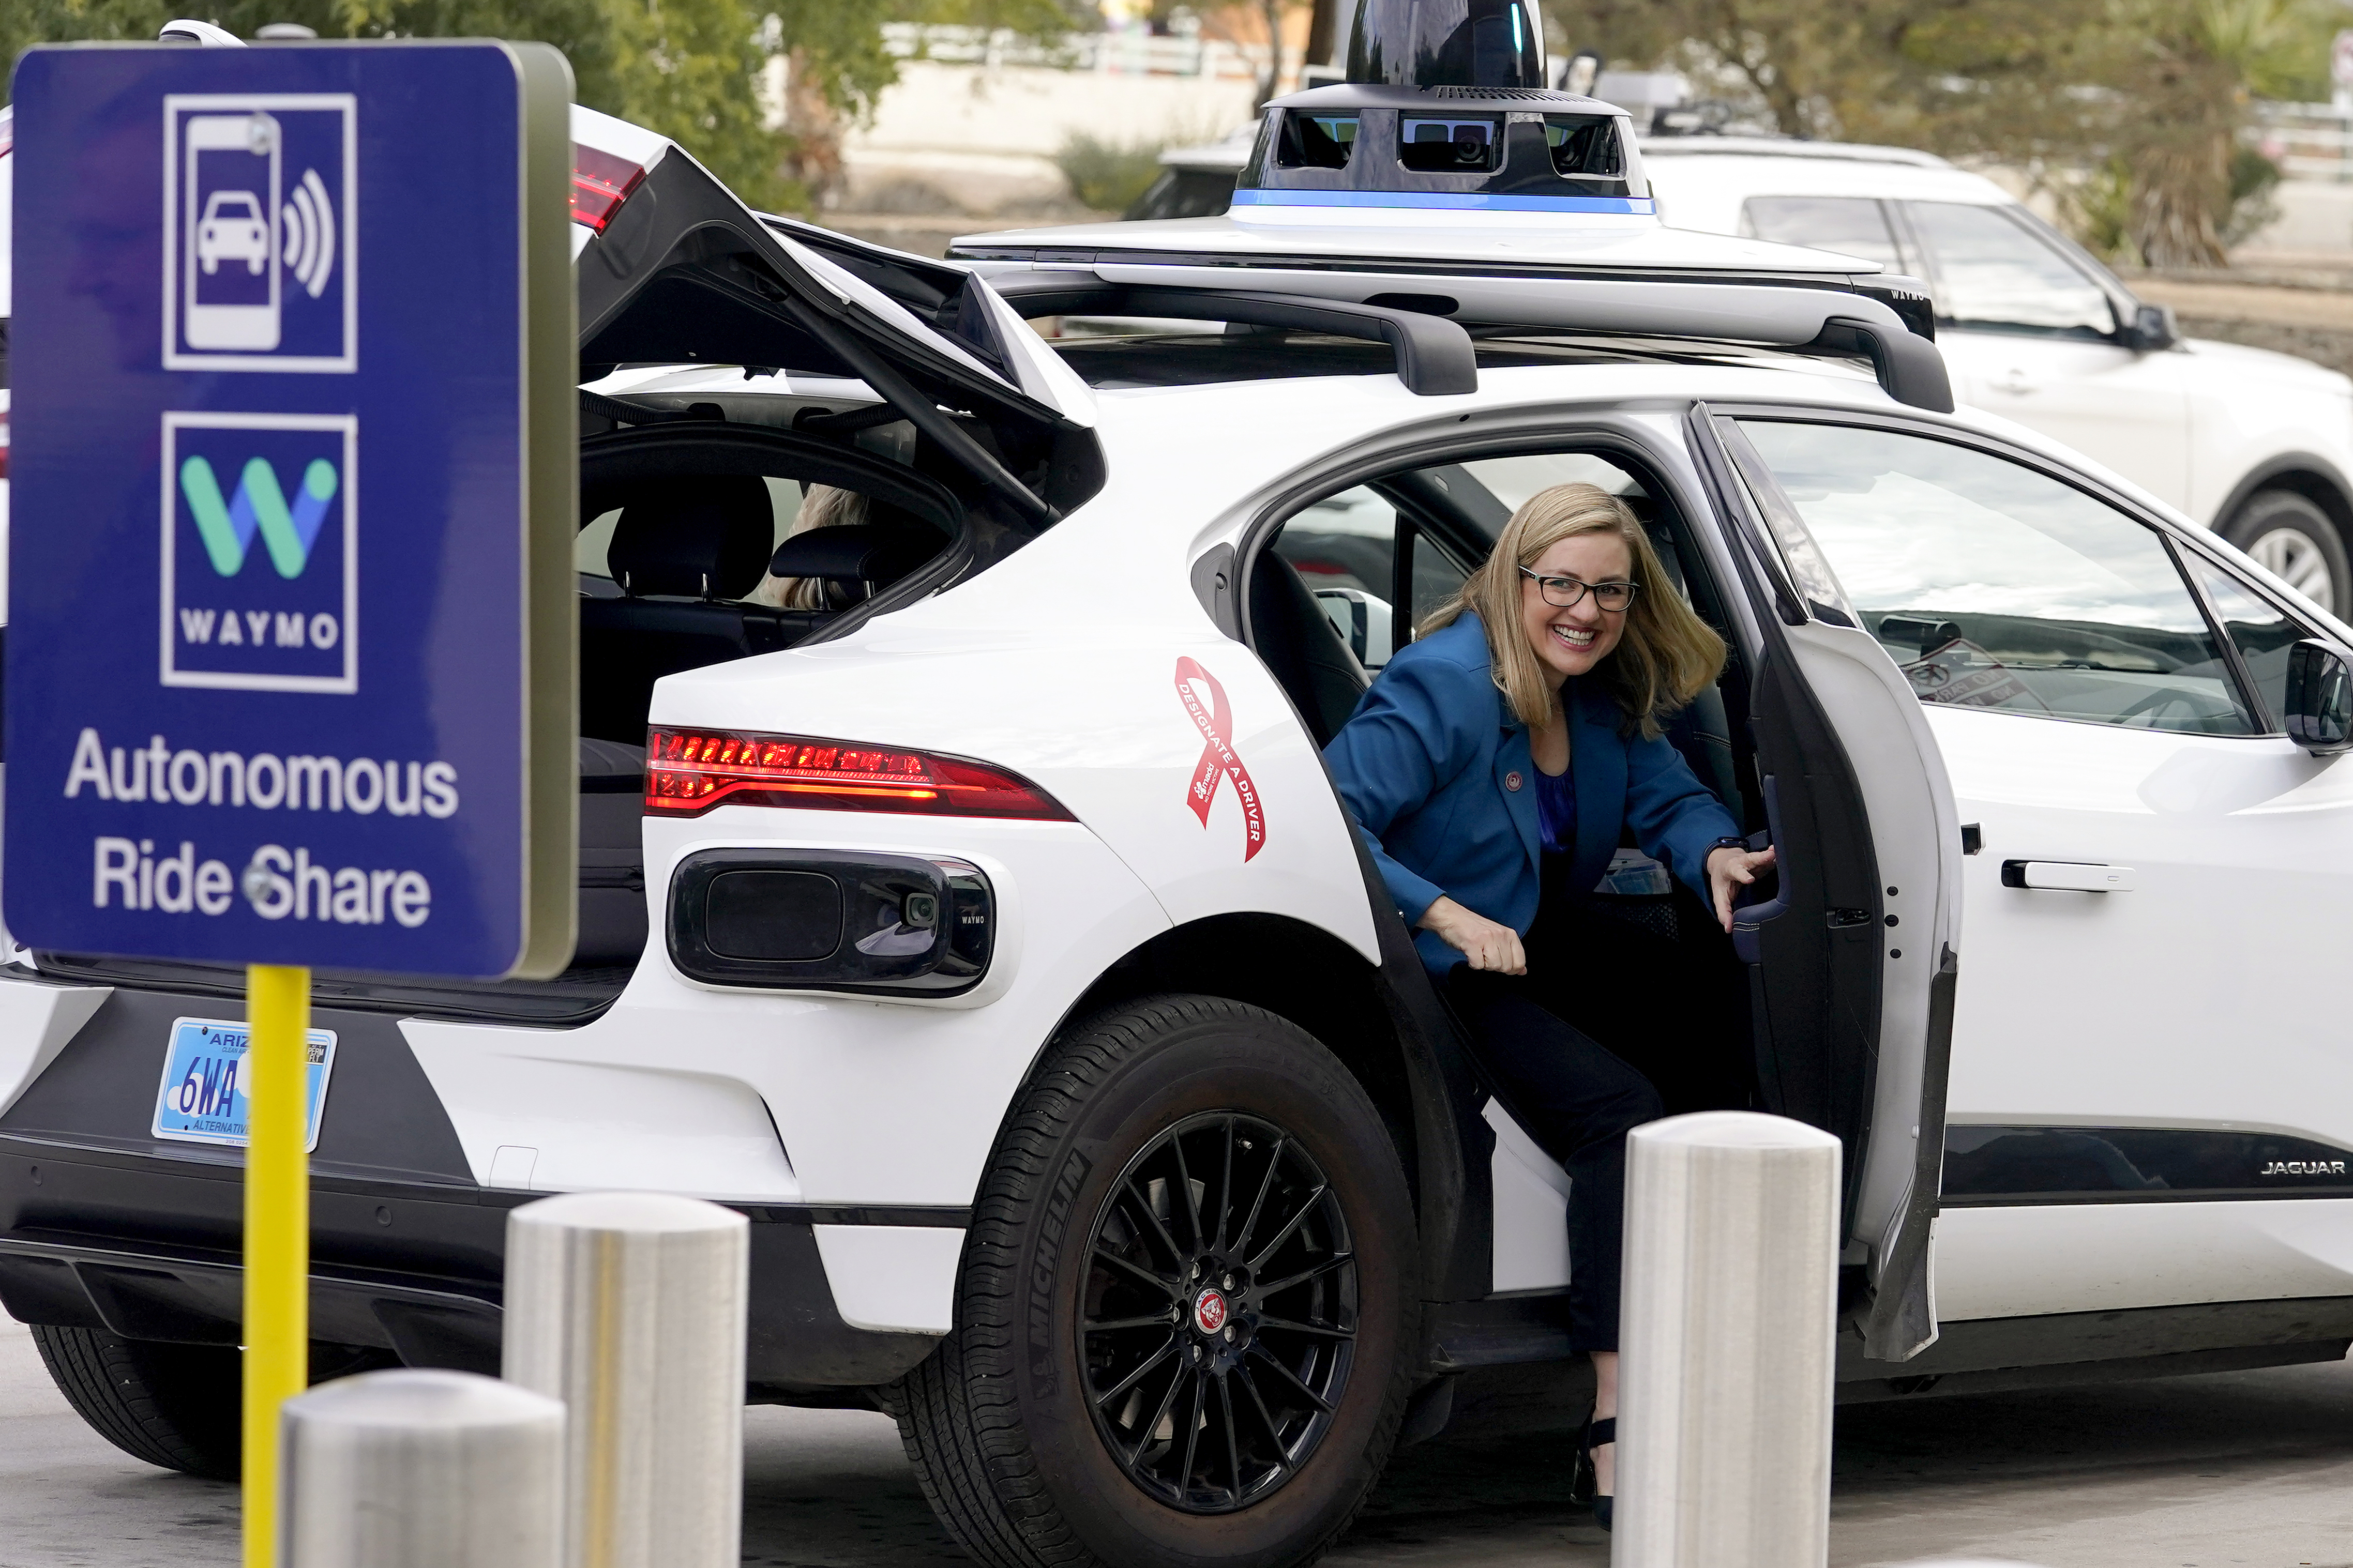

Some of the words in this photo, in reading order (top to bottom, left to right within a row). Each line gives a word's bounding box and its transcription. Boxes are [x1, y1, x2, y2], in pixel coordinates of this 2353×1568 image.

[1891, 290, 1924, 301] WAYMO
[179, 607, 339, 649] WAYMO
[64, 726, 459, 819] Autonomous
[1179, 683, 1234, 764] DESIGNATE
[1230, 766, 1241, 778] A
[1238, 780, 1260, 842] DRIVER
[1202, 762, 1215, 789] madd
[93, 835, 234, 916] Ride
[247, 843, 431, 928] Share
[962, 916, 984, 924] WAYMO
[209, 1033, 251, 1048] ARIZ
[307, 1047, 325, 1056] PERM
[179, 1056, 238, 1118] 6WA
[2260, 1161, 2346, 1175] JAGUAR
[1029, 1151, 1087, 1347] MICHELIN
